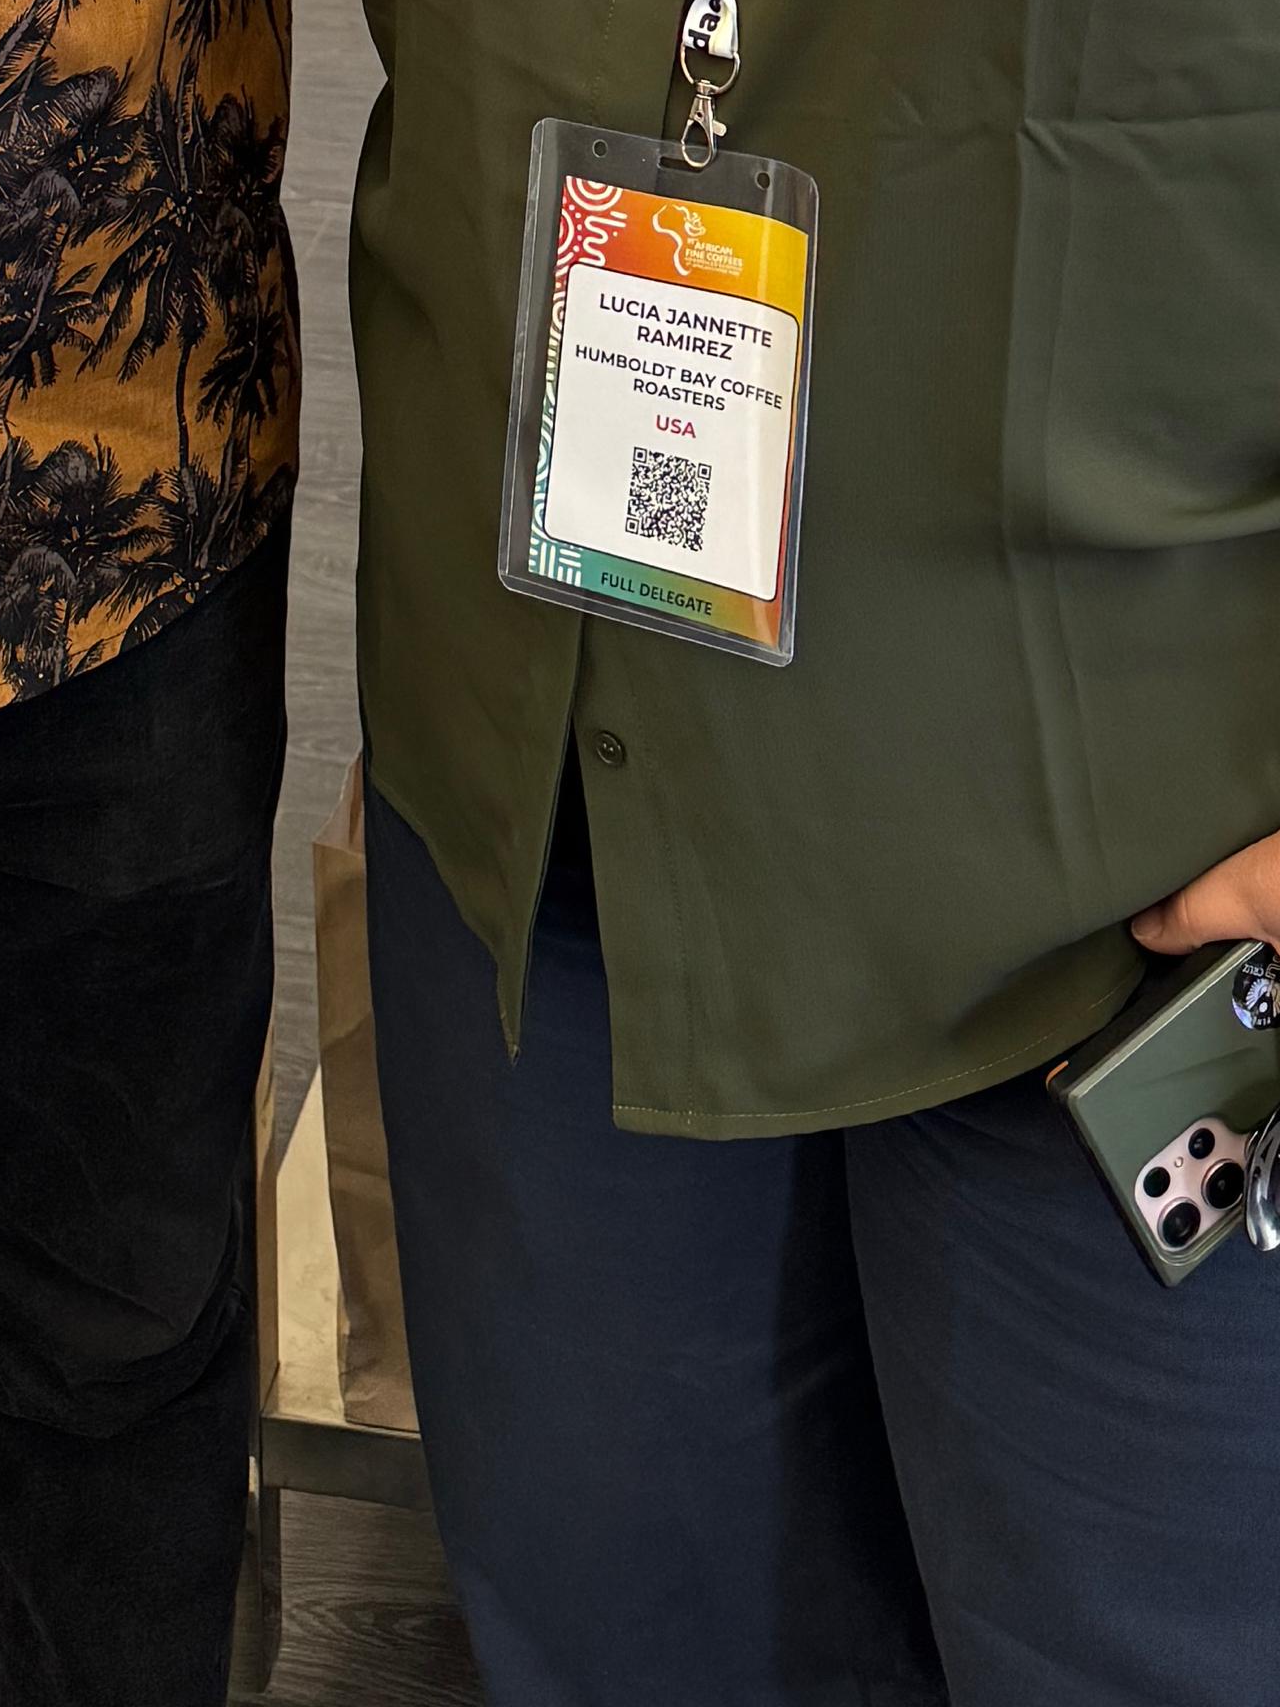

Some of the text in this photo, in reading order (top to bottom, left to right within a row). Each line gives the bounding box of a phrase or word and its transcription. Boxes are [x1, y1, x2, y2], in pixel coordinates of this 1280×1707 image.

[685, 249, 705, 260] FINE
[599, 293, 773, 348] LUCIA JANNETTE
[637, 325, 733, 361] RAMIREZ
[575, 344, 783, 410] HUMBOLDT BAY COFFEE
[633, 378, 726, 411] ROASTERS
[656, 414, 696, 439] USA
[601, 572, 713, 616] FULL DELEGATE
